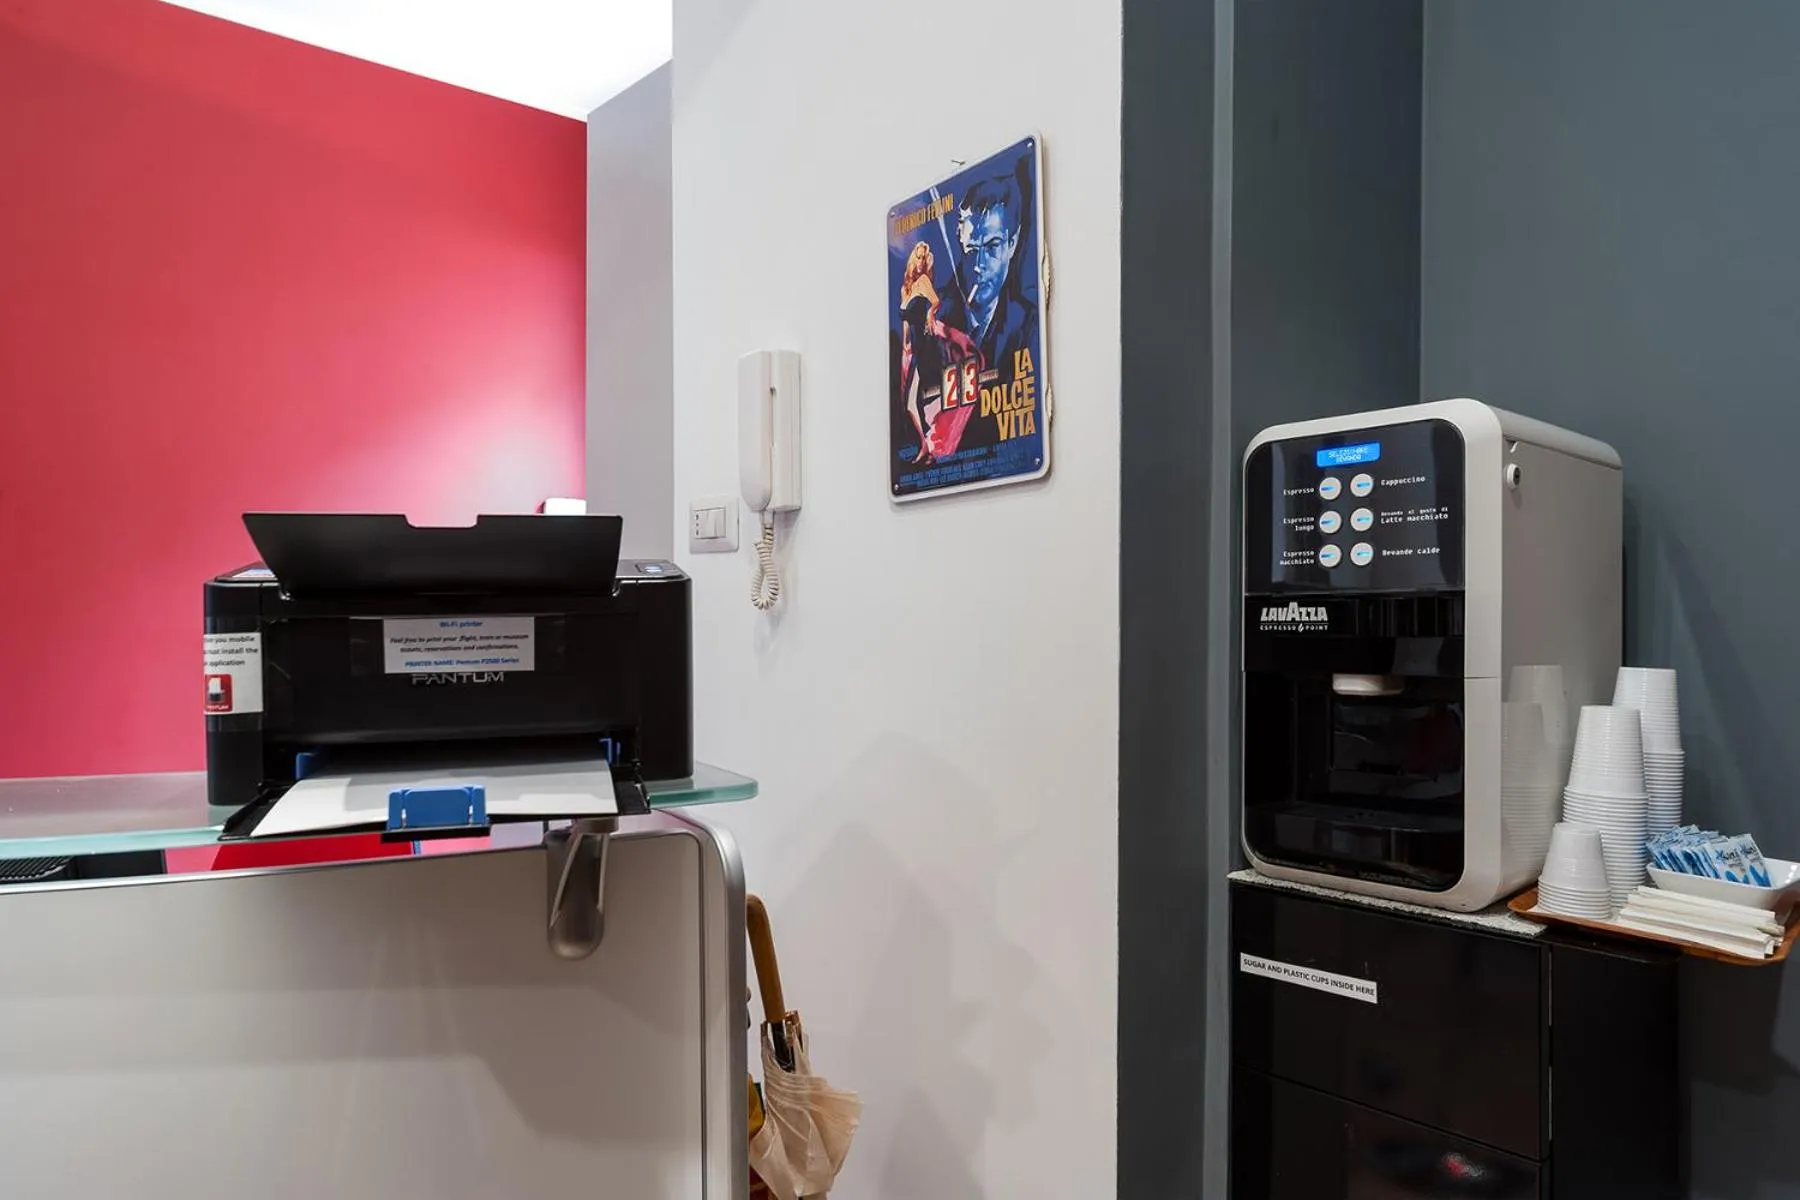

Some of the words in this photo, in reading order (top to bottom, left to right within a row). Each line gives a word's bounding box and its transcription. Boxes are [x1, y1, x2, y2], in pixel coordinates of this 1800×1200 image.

[1014, 347, 1034, 380] LA
[980, 376, 1035, 418] DOLCE
[996, 406, 1037, 441] VITA
[1381, 476, 1426, 486] Cappuccino
[1283, 487, 1315, 496] Espresso
[1283, 517, 1315, 525] Espresso
[1381, 516, 1403, 524] Latte
[1407, 513, 1449, 521] macchiato
[1283, 550, 1315, 559] Espresso
[1382, 548, 1413, 556] Bevande
[1260, 601, 1328, 621] LAVAZZA
[411, 672, 505, 685] PANTUM
[1243, 958, 1266, 970] SUGAR
[1267, 964, 1283, 974] AND
[1283, 968, 1310, 981] PLASTIC
[1311, 974, 1330, 985] CUPS
[1330, 978, 1354, 991] INSIDE
[1355, 985, 1375, 996] HERE
